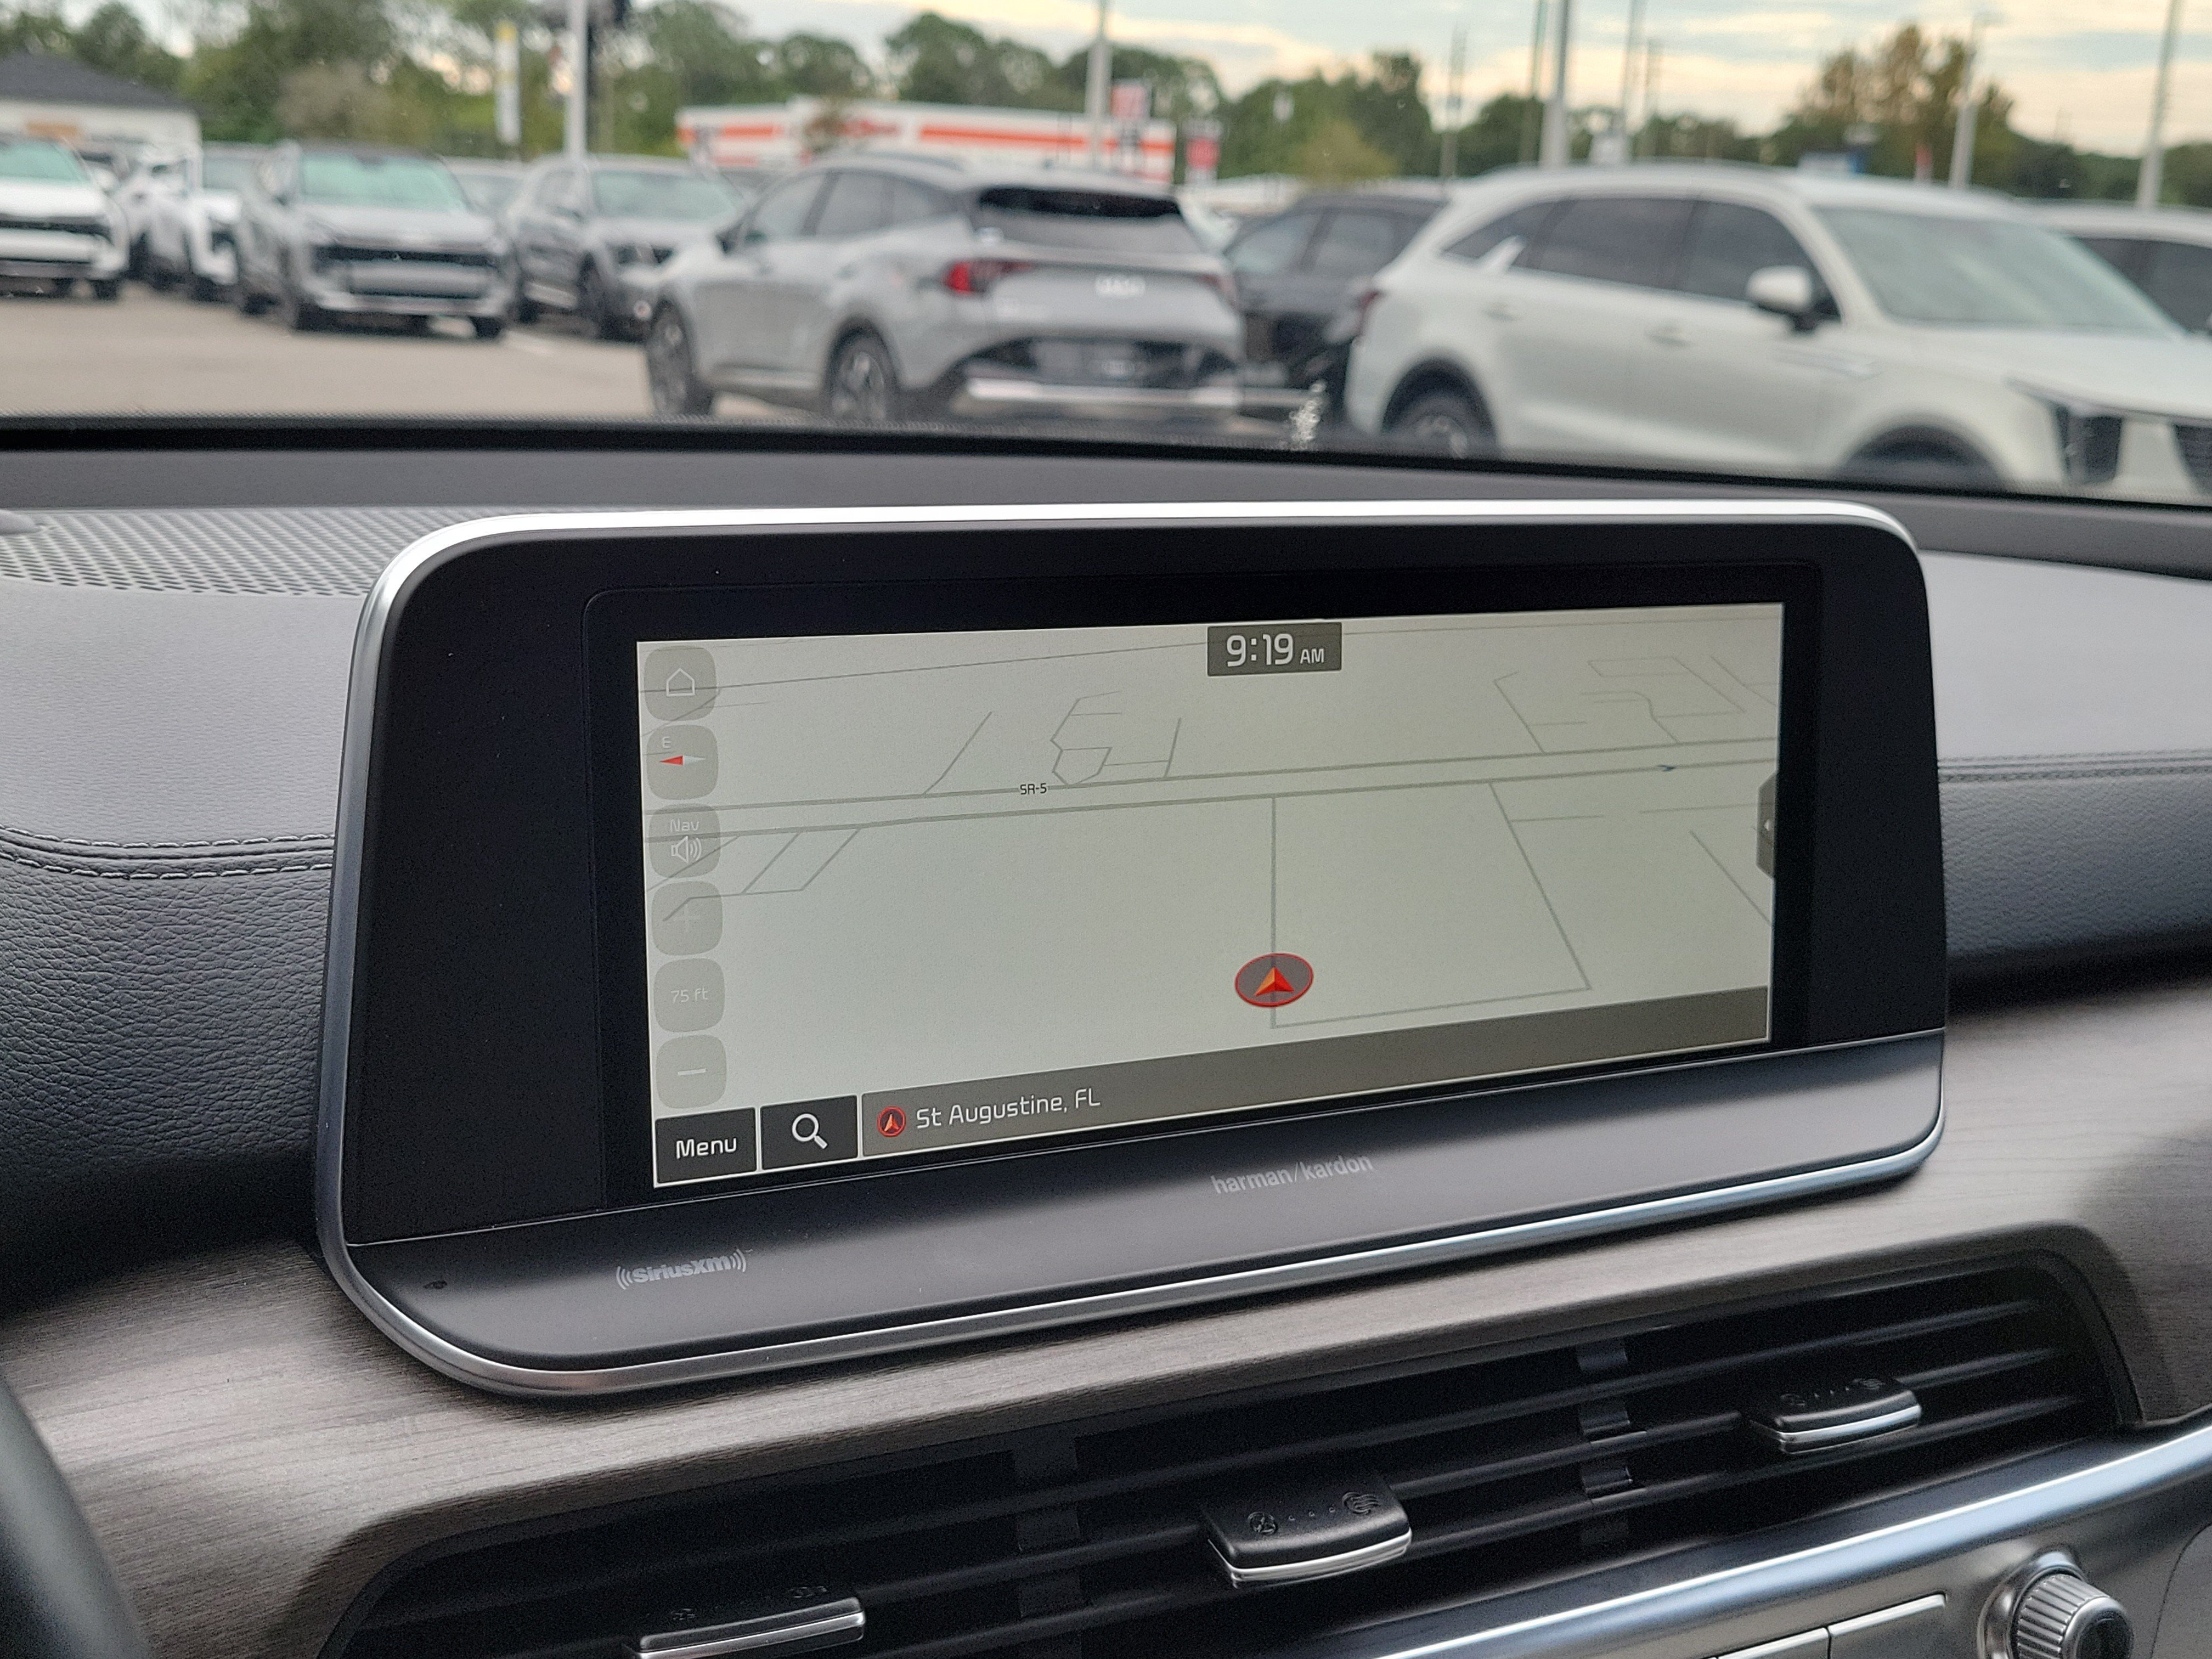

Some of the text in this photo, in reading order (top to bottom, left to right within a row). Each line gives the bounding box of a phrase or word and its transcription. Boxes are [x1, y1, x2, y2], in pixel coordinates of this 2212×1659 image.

[1226, 633, 1325, 667] 9:19 AM
[662, 736, 672, 749] E
[1019, 782, 1047, 795] SR-5
[669, 818, 700, 833] Nav
[670, 986, 709, 1003] 75 ft
[915, 1087, 1101, 1130] St Augustine, FL
[675, 1137, 737, 1160] Menu
